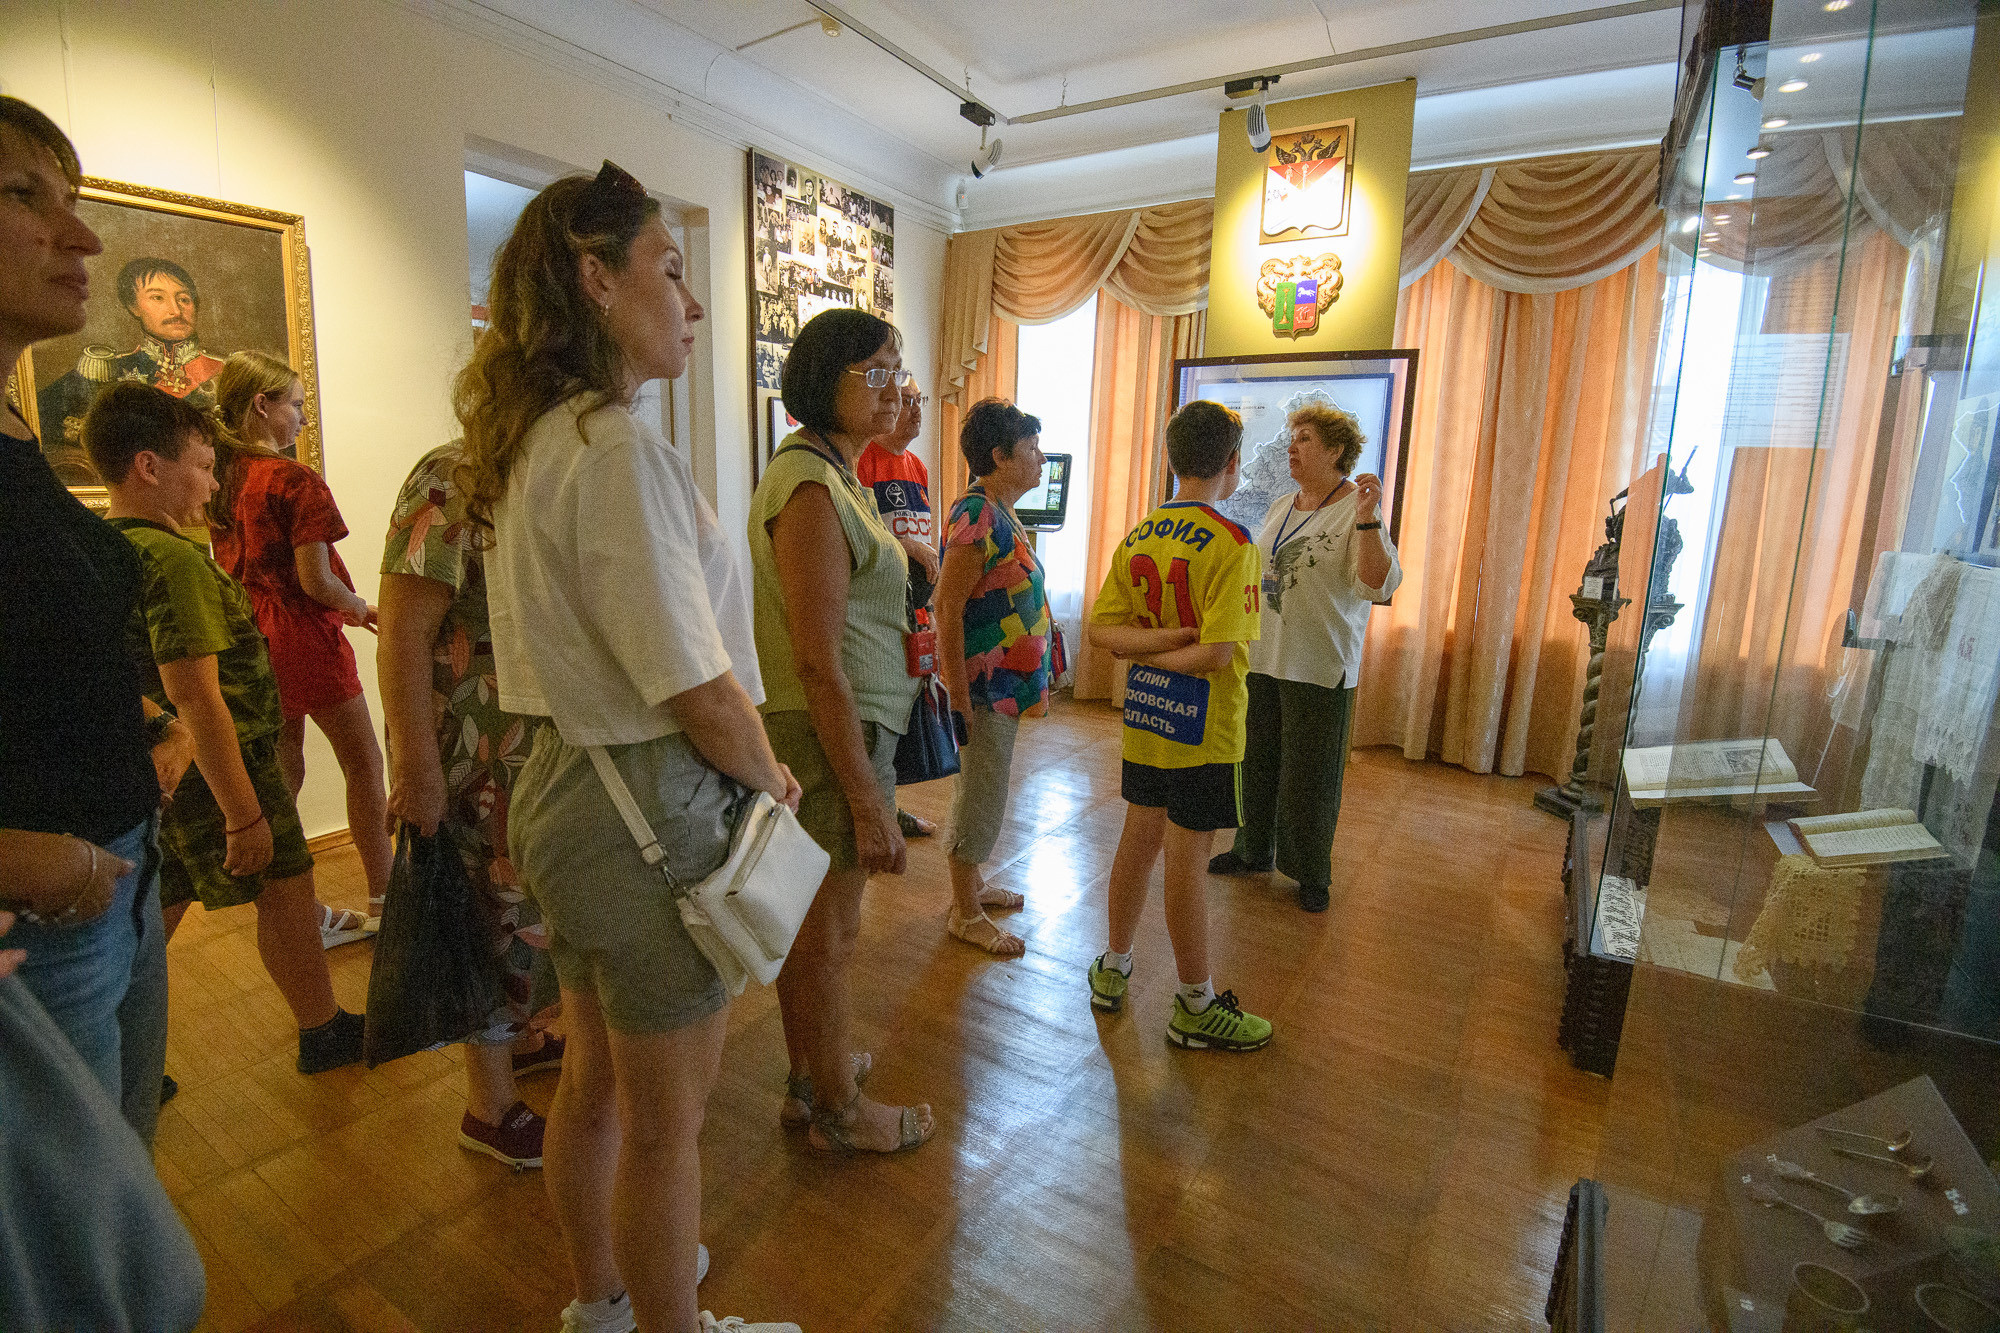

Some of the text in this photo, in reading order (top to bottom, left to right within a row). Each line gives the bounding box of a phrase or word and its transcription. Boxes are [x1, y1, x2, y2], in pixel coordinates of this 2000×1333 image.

[1125, 518, 1215, 551] СОФИЯ
[1130, 554, 1197, 628] 31
[1244, 584, 1260, 613] 31
[1133, 669, 1171, 689] КЛИН
